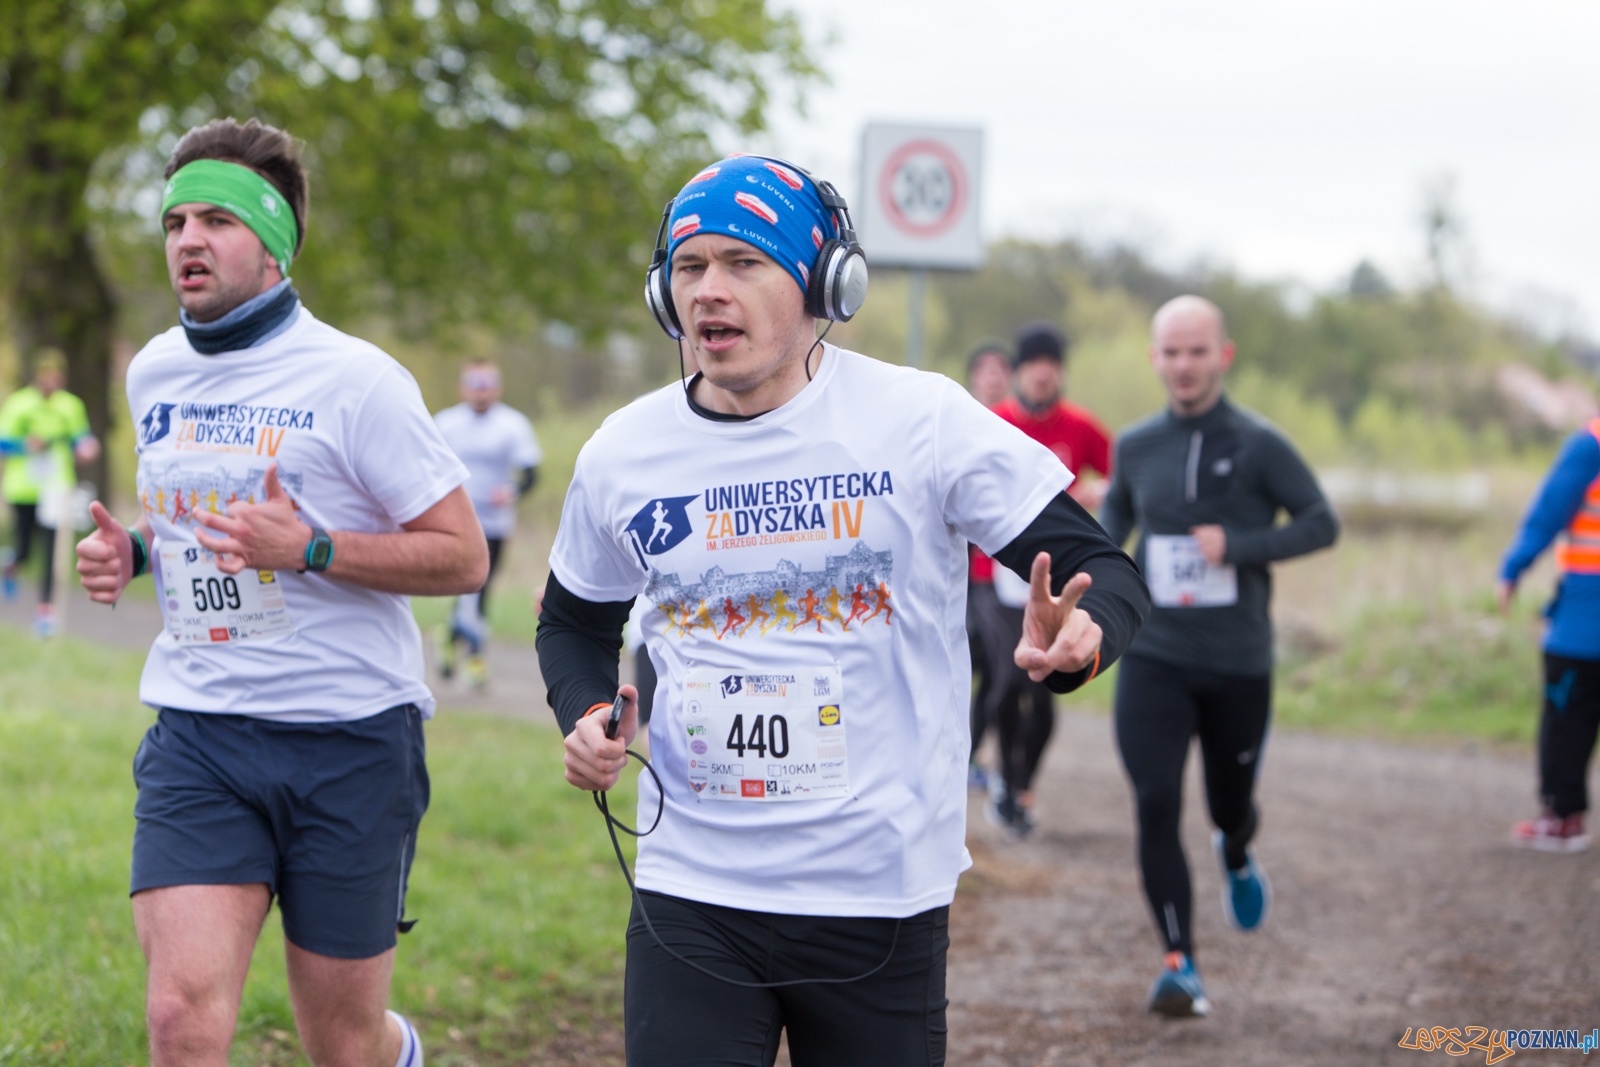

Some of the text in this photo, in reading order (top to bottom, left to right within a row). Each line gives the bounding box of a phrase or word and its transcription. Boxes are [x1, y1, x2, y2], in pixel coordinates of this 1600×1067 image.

[676, 191, 706, 207] LUVENA
[761, 181, 795, 211] LUVENA
[743, 229, 778, 251] LUVENA
[181, 402, 314, 430] UNIWERSYTECKA
[177, 422, 255, 445] ZADYSZKA
[256, 427, 285, 457] IV
[705, 471, 894, 512] UNIWERSYTECKA
[706, 499, 864, 540] ZADYSZKA IV
[706, 530, 827, 551] IM. JERZEGO ŻELIGOWSKIEGO
[191, 576, 241, 612] 509
[745, 675, 796, 685] UNIWERSYTECKA
[746, 684, 778, 694] ZADYSZKA
[778, 685, 787, 698] IV
[726, 714, 789, 759] 440
[711, 764, 731, 775] 5KM
[782, 763, 816, 776] 10KM
